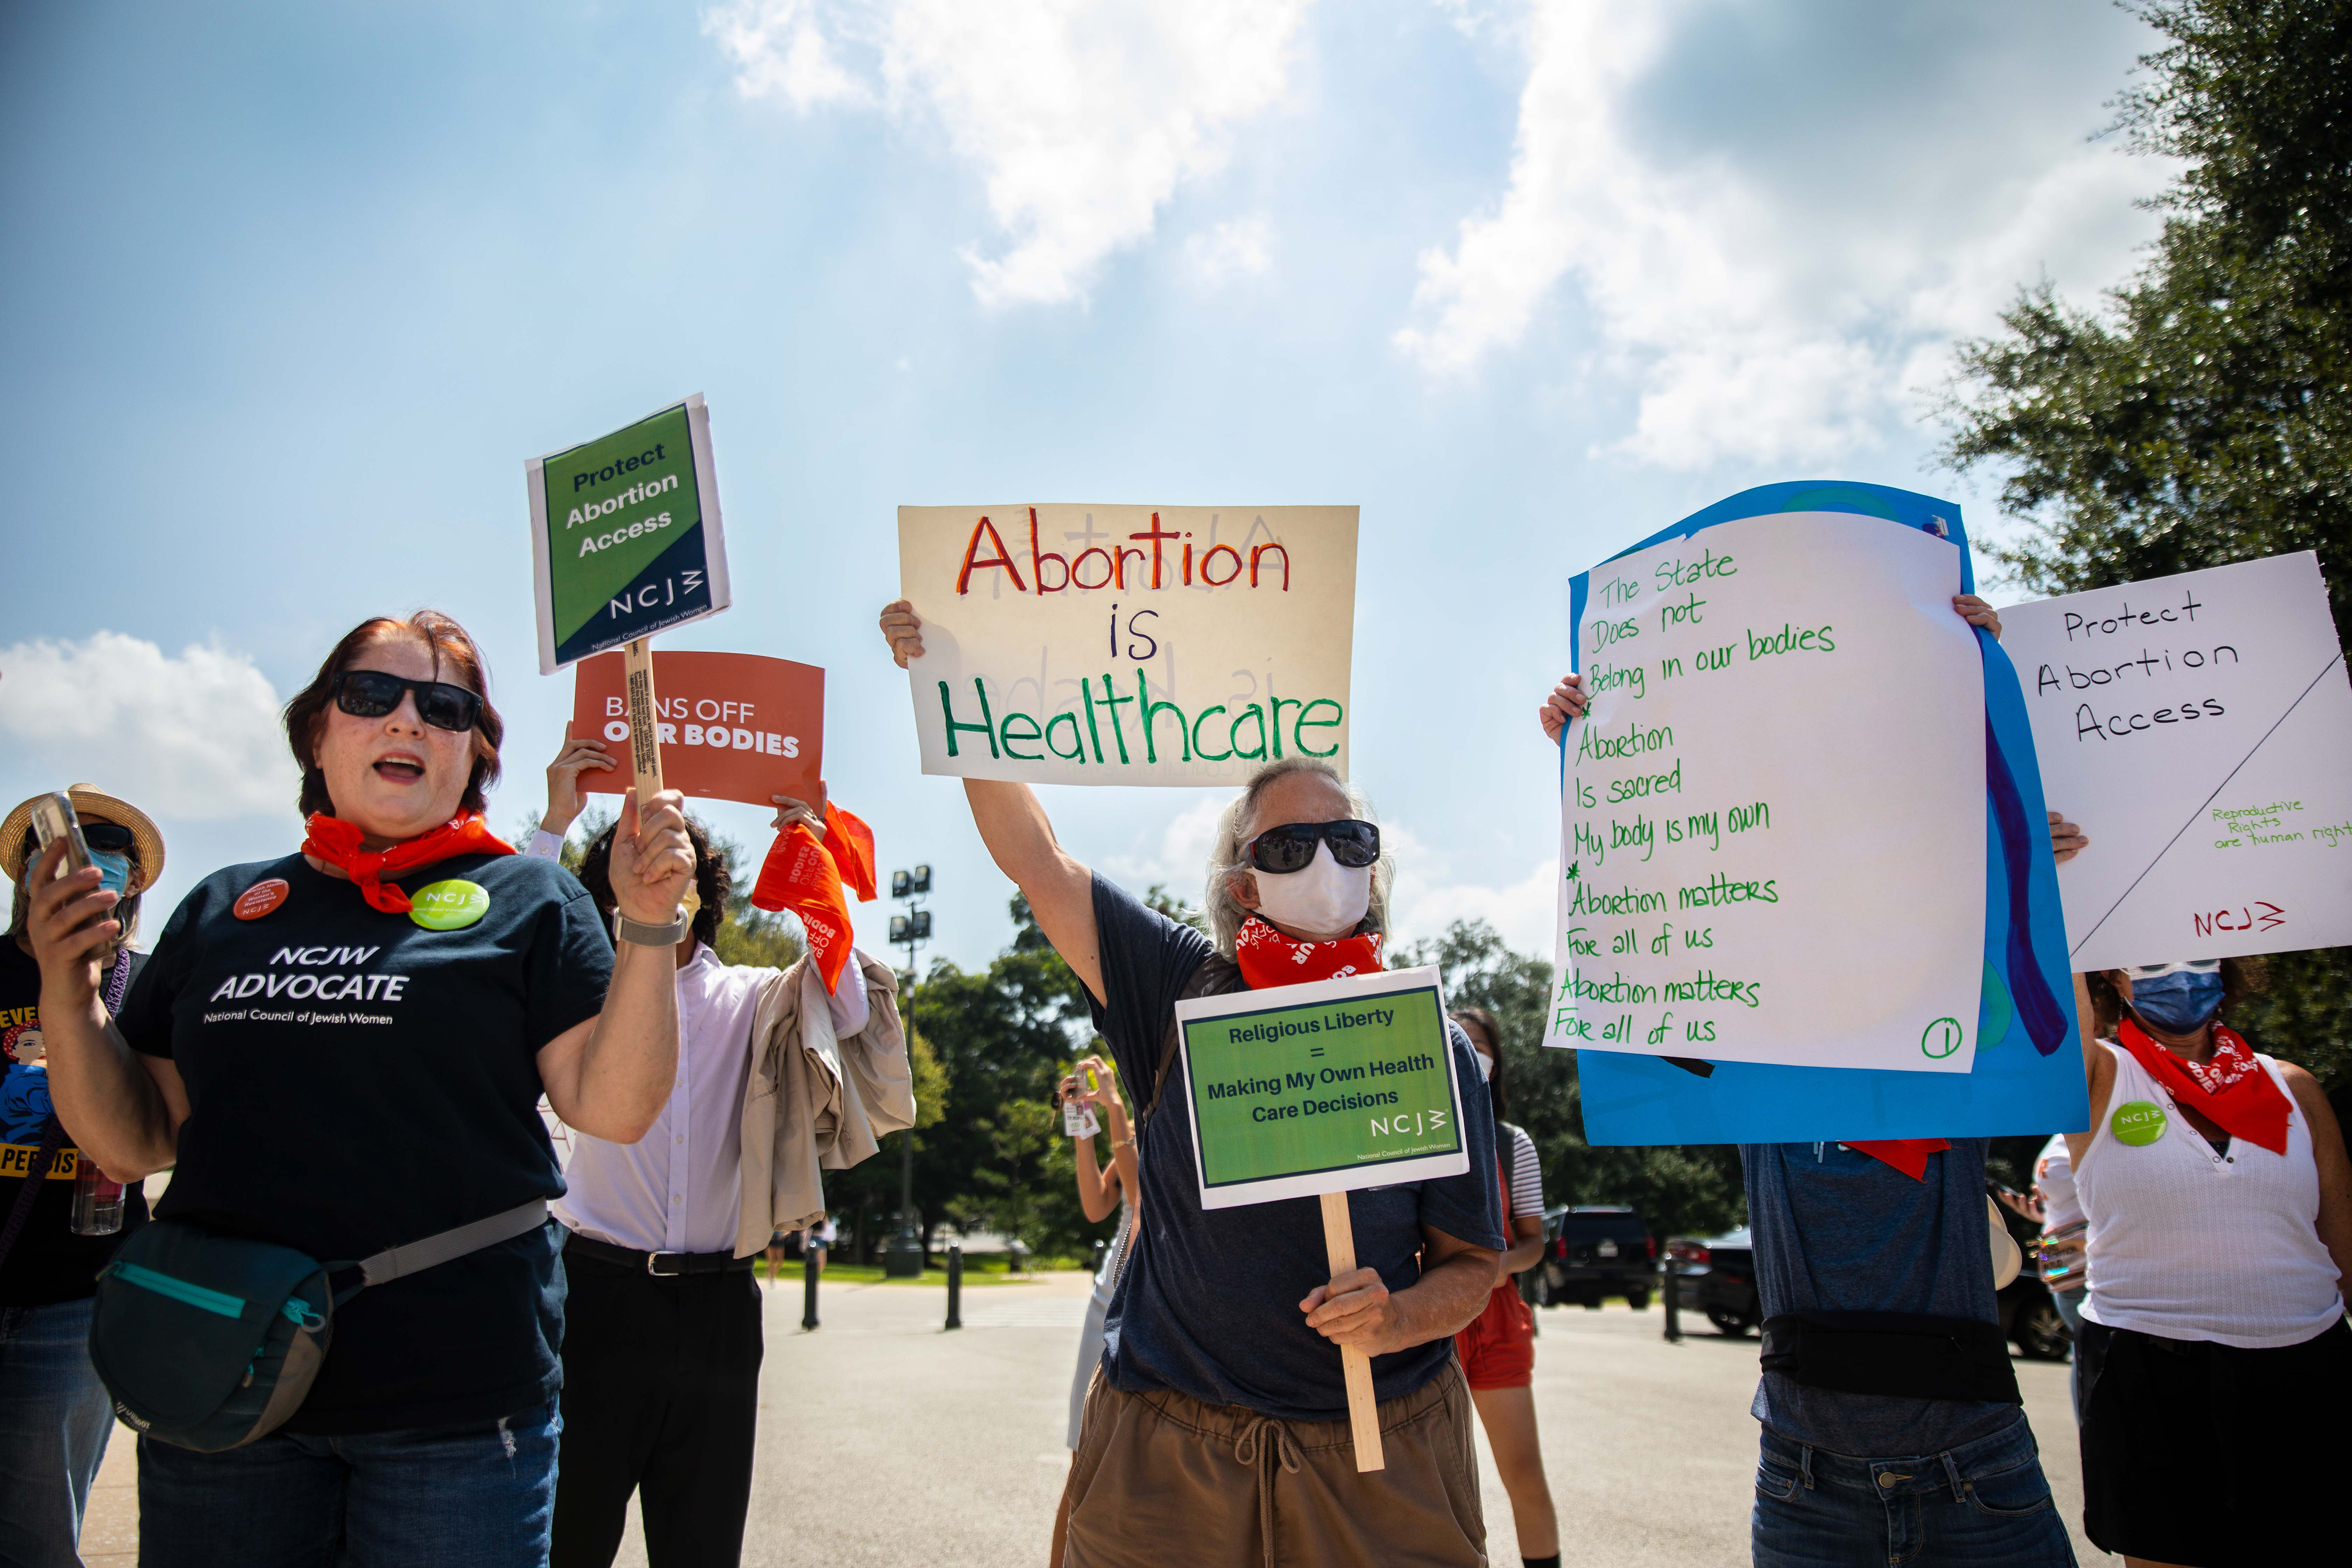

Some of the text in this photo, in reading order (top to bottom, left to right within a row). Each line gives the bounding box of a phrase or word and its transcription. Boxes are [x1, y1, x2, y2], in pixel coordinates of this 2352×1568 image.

[574, 443, 666, 493] Protect
[566, 475, 678, 529] Abortion
[579, 511, 672, 558] Access
[955, 506, 1290, 596] Abortion
[1600, 549, 1738, 608] The State
[592, 636, 620, 651] National
[622, 626, 648, 640] Council
[658, 614, 680, 629] Jewish
[681, 604, 707, 618] Women
[1110, 603, 1160, 661] is
[1591, 593, 1707, 654] Does not
[2065, 590, 2202, 642] Protect
[1586, 623, 1836, 700] Belong in our bodies
[2039, 645, 2239, 696] Abortion
[606, 697, 688, 719] BNS
[696, 699, 754, 724] OFF
[938, 668, 1344, 765] Healthcare
[2077, 699, 2225, 742] Access
[604, 721, 800, 759] OR BODIES
[1576, 758, 1681, 808] Is sacred
[2213, 801, 2304, 822] Reproductive
[2228, 817, 2281, 838] Rights
[1575, 822, 1604, 866] My
[1610, 814, 1653, 862] body
[1689, 812, 1719, 851] my
[1728, 802, 1770, 833] own
[2215, 821, 2352, 848] are human right
[244, 895, 276, 907] Resistance
[802, 910, 836, 939] BODIE
[809, 932, 829, 948] OFF
[1612, 929, 1636, 955] all
[1652, 924, 1673, 956] of
[1686, 927, 1714, 949] us
[269, 947, 381, 965] NCJW
[210, 973, 410, 1002] ADVOCATE
[0, 1006, 40, 1028] EVE
[204, 1009, 394, 1026] National Council of Jewish Women
[1229, 1008, 1394, 1044] Religious Liberty
[1602, 1014, 1631, 1043] all
[1648, 1012, 1674, 1044] of
[1687, 1020, 1716, 1042] us
[1208, 1054, 1435, 1100] Making My Own Health
[2188, 1061, 2217, 1094] ODIES
[1252, 1088, 1399, 1123] Care Decisions
[1357, 1152, 1380, 1160] National
[1411, 1146, 1428, 1154] Jewish
